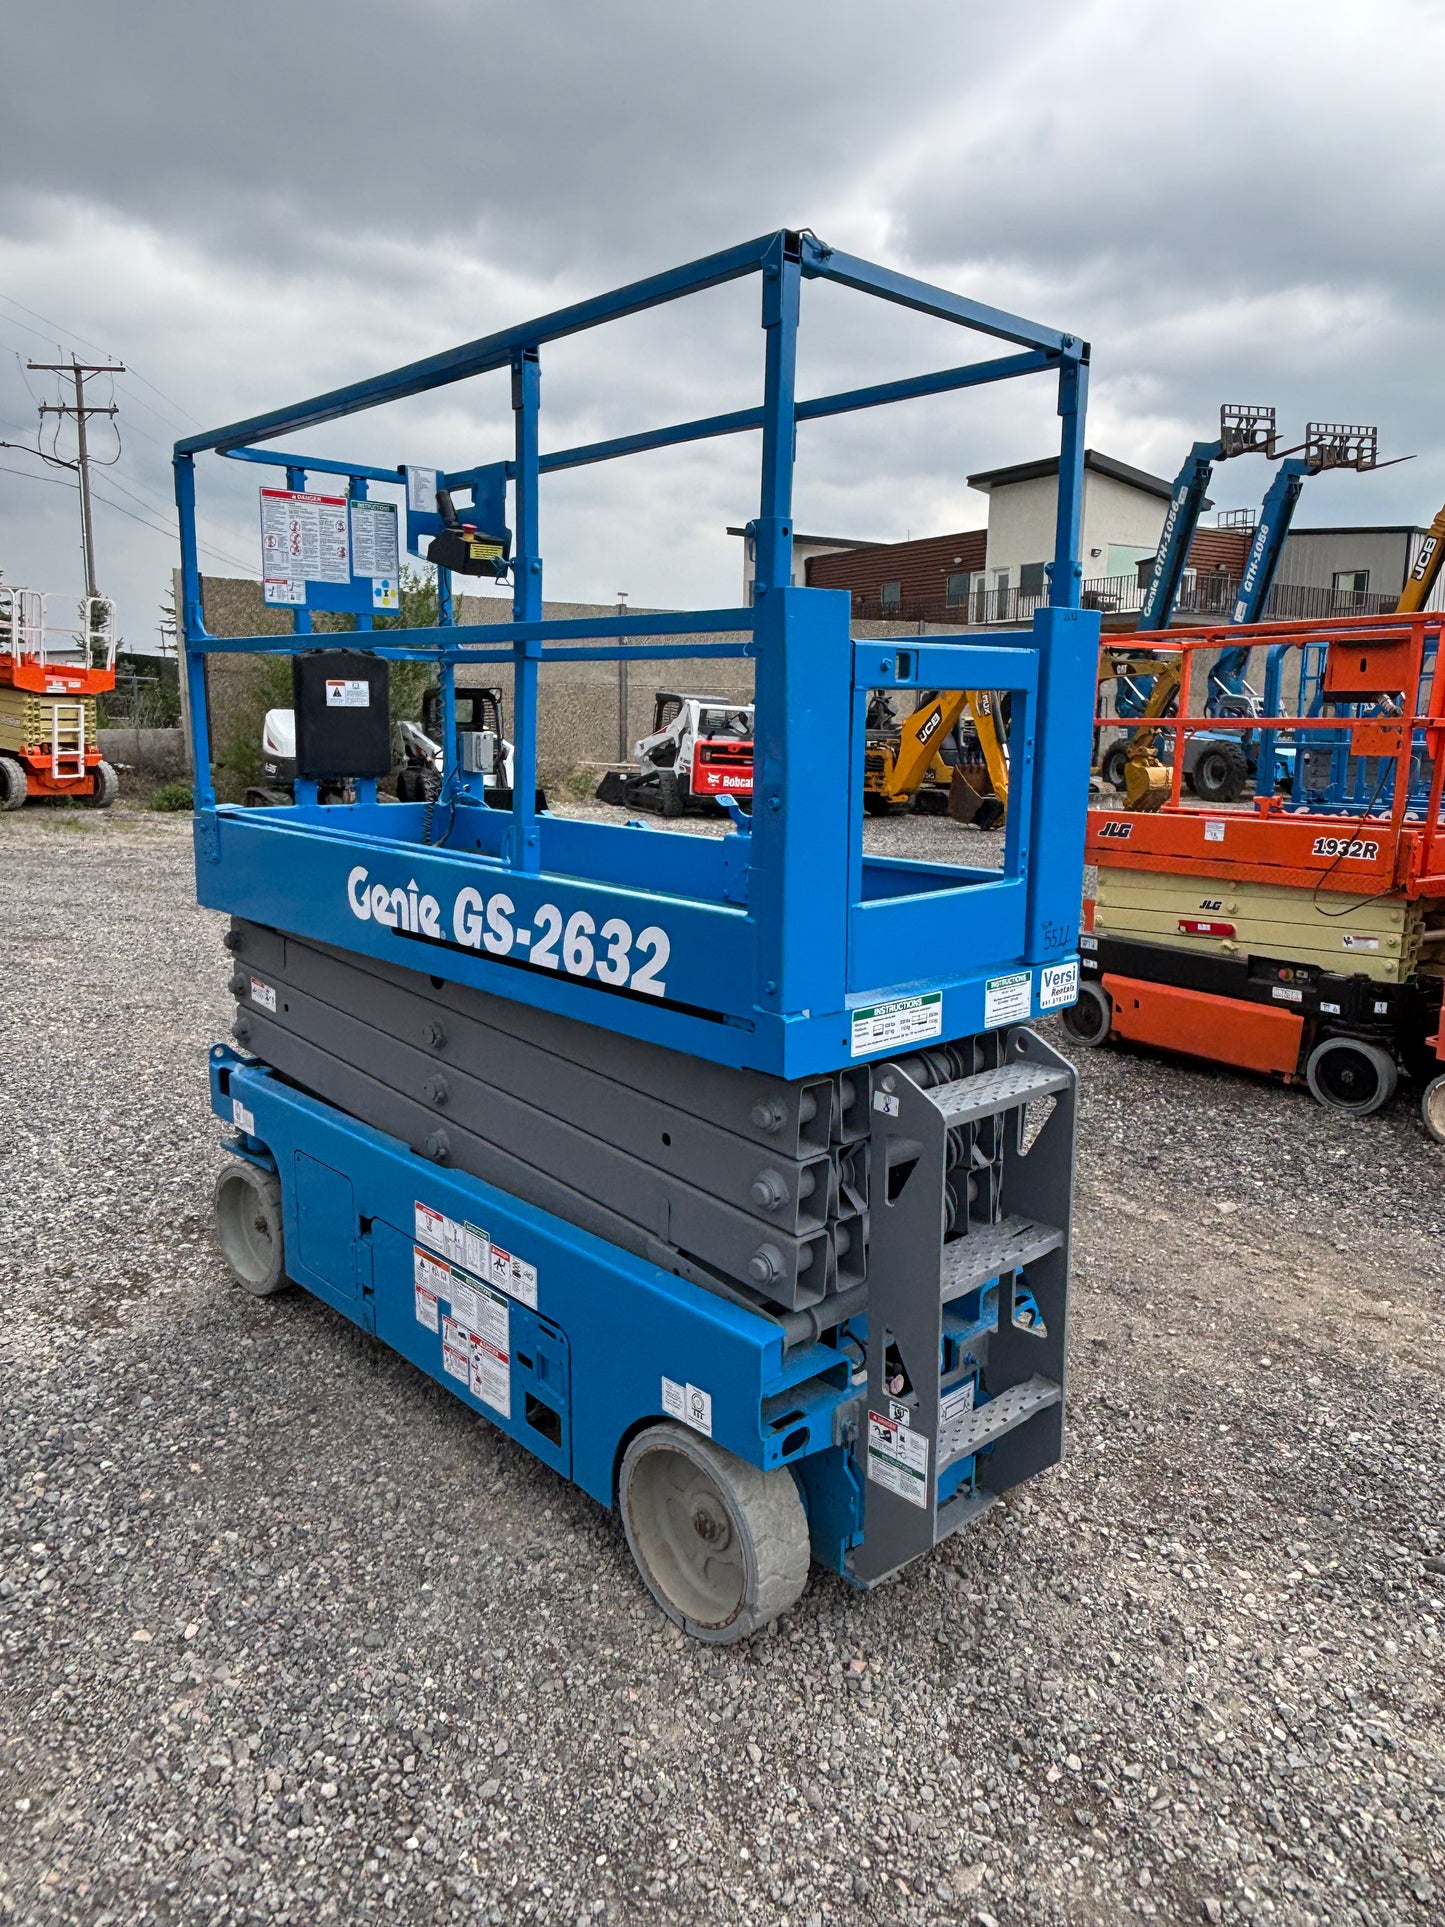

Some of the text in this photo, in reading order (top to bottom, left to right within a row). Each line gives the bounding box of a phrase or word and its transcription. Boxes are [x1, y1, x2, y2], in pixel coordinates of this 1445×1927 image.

[1154, 499, 1180, 578] GTH-1056
[1244, 523, 1270, 593] GTH-1056
[1414, 537, 1438, 580] JCB
[918, 712, 941, 743] JCB
[1097, 821, 1133, 839] JLG
[1311, 837, 1379, 861] 1932R
[1198, 900, 1222, 911] JLG
[346, 864, 671, 998] Genie GS-2632
[990, 973, 1027, 989] INSTRUCTIONS
[1043, 965, 1076, 988] Versi
[873, 997, 923, 1016] INSTRUCTIONS
